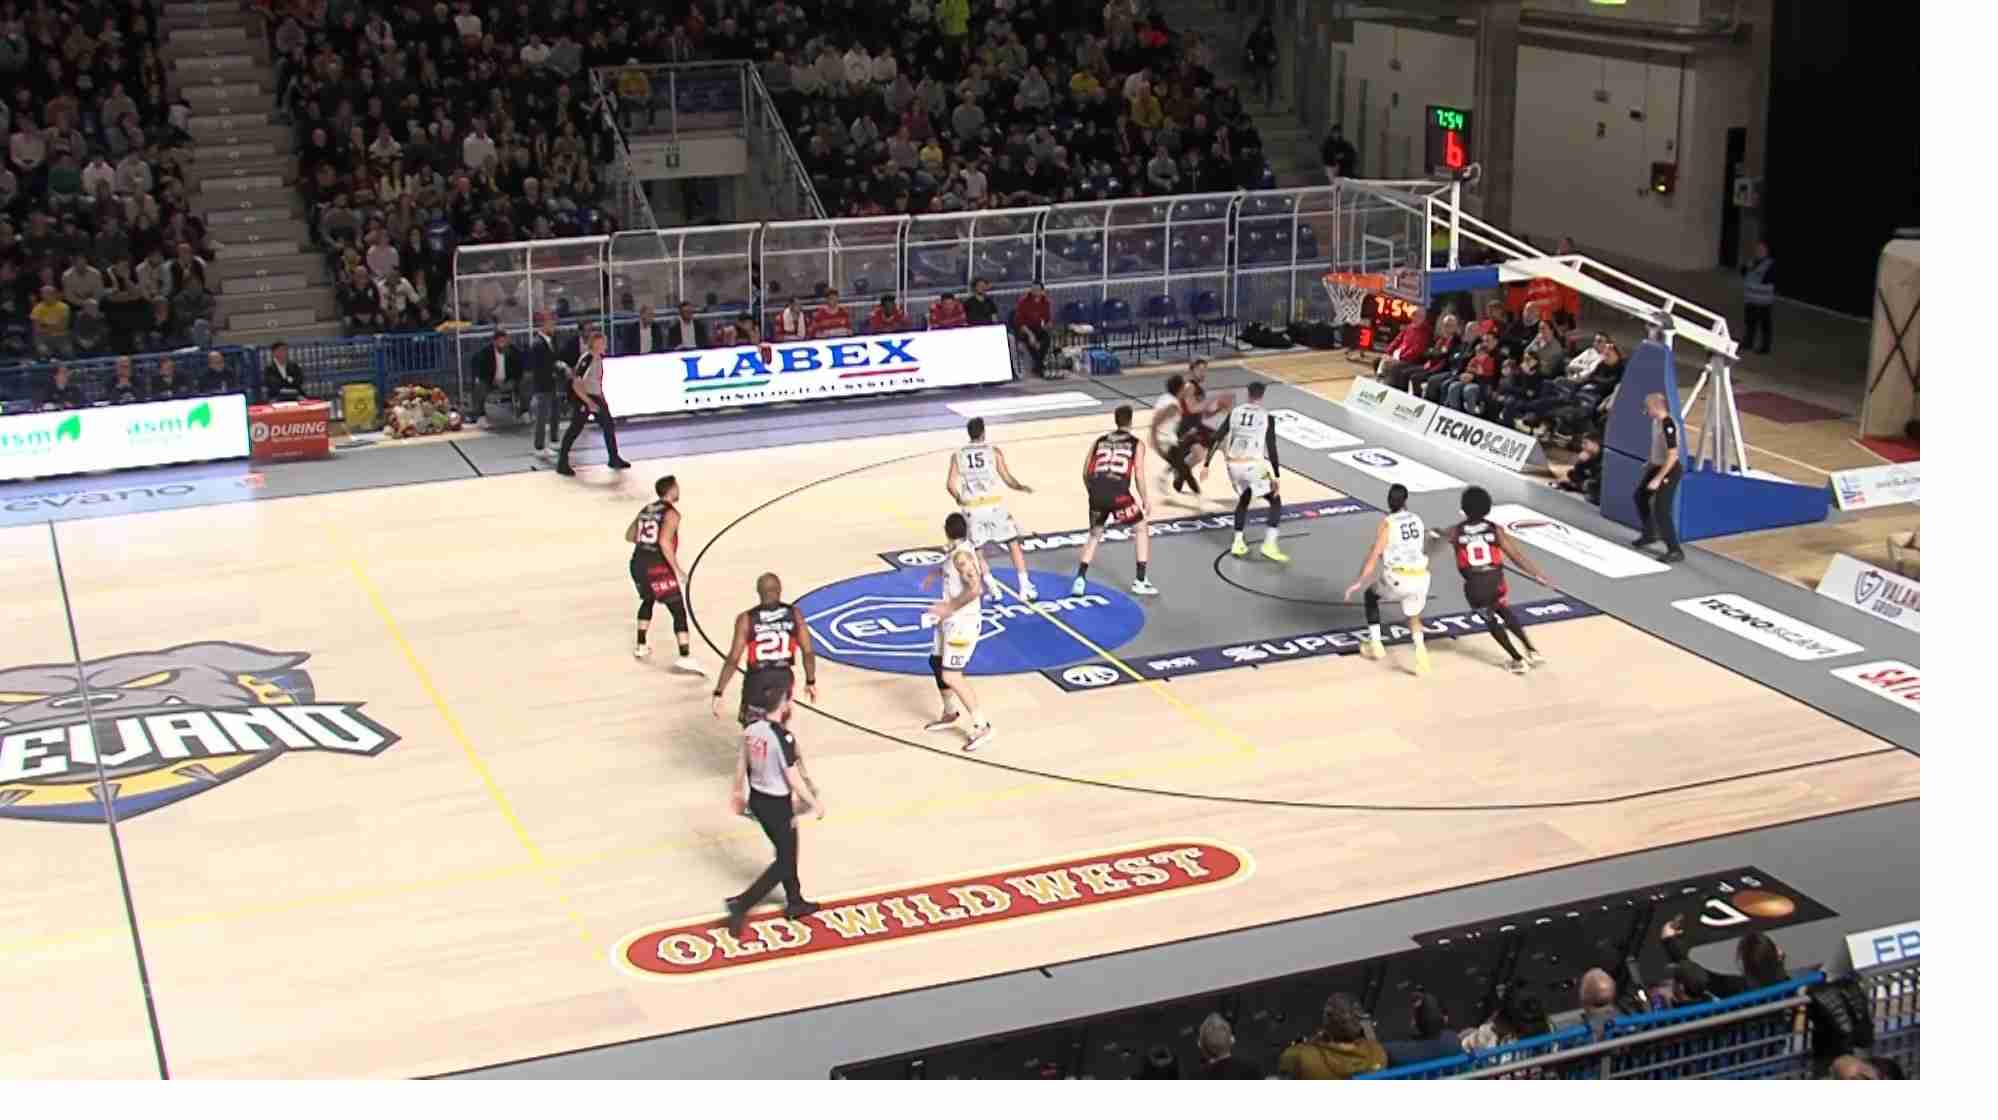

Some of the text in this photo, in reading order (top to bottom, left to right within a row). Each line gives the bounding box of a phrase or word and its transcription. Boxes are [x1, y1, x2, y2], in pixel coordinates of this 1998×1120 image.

[1435, 109, 1464, 129] 7:54
[680, 337, 919, 383] LABEX
[271, 421, 328, 436] DURING
[1240, 413, 1255, 426] 11
[1434, 414, 1529, 463] TECNOSCAVI
[967, 453, 985, 469] 15
[1095, 448, 1132, 473] 25
[1400, 522, 1420, 541] 66
[1467, 537, 1493, 567] 0
[1699, 598, 1838, 655] TECNOSCAVI
[755, 631, 793, 662] 21
[656, 845, 1206, 966] OLD WILD WEST
